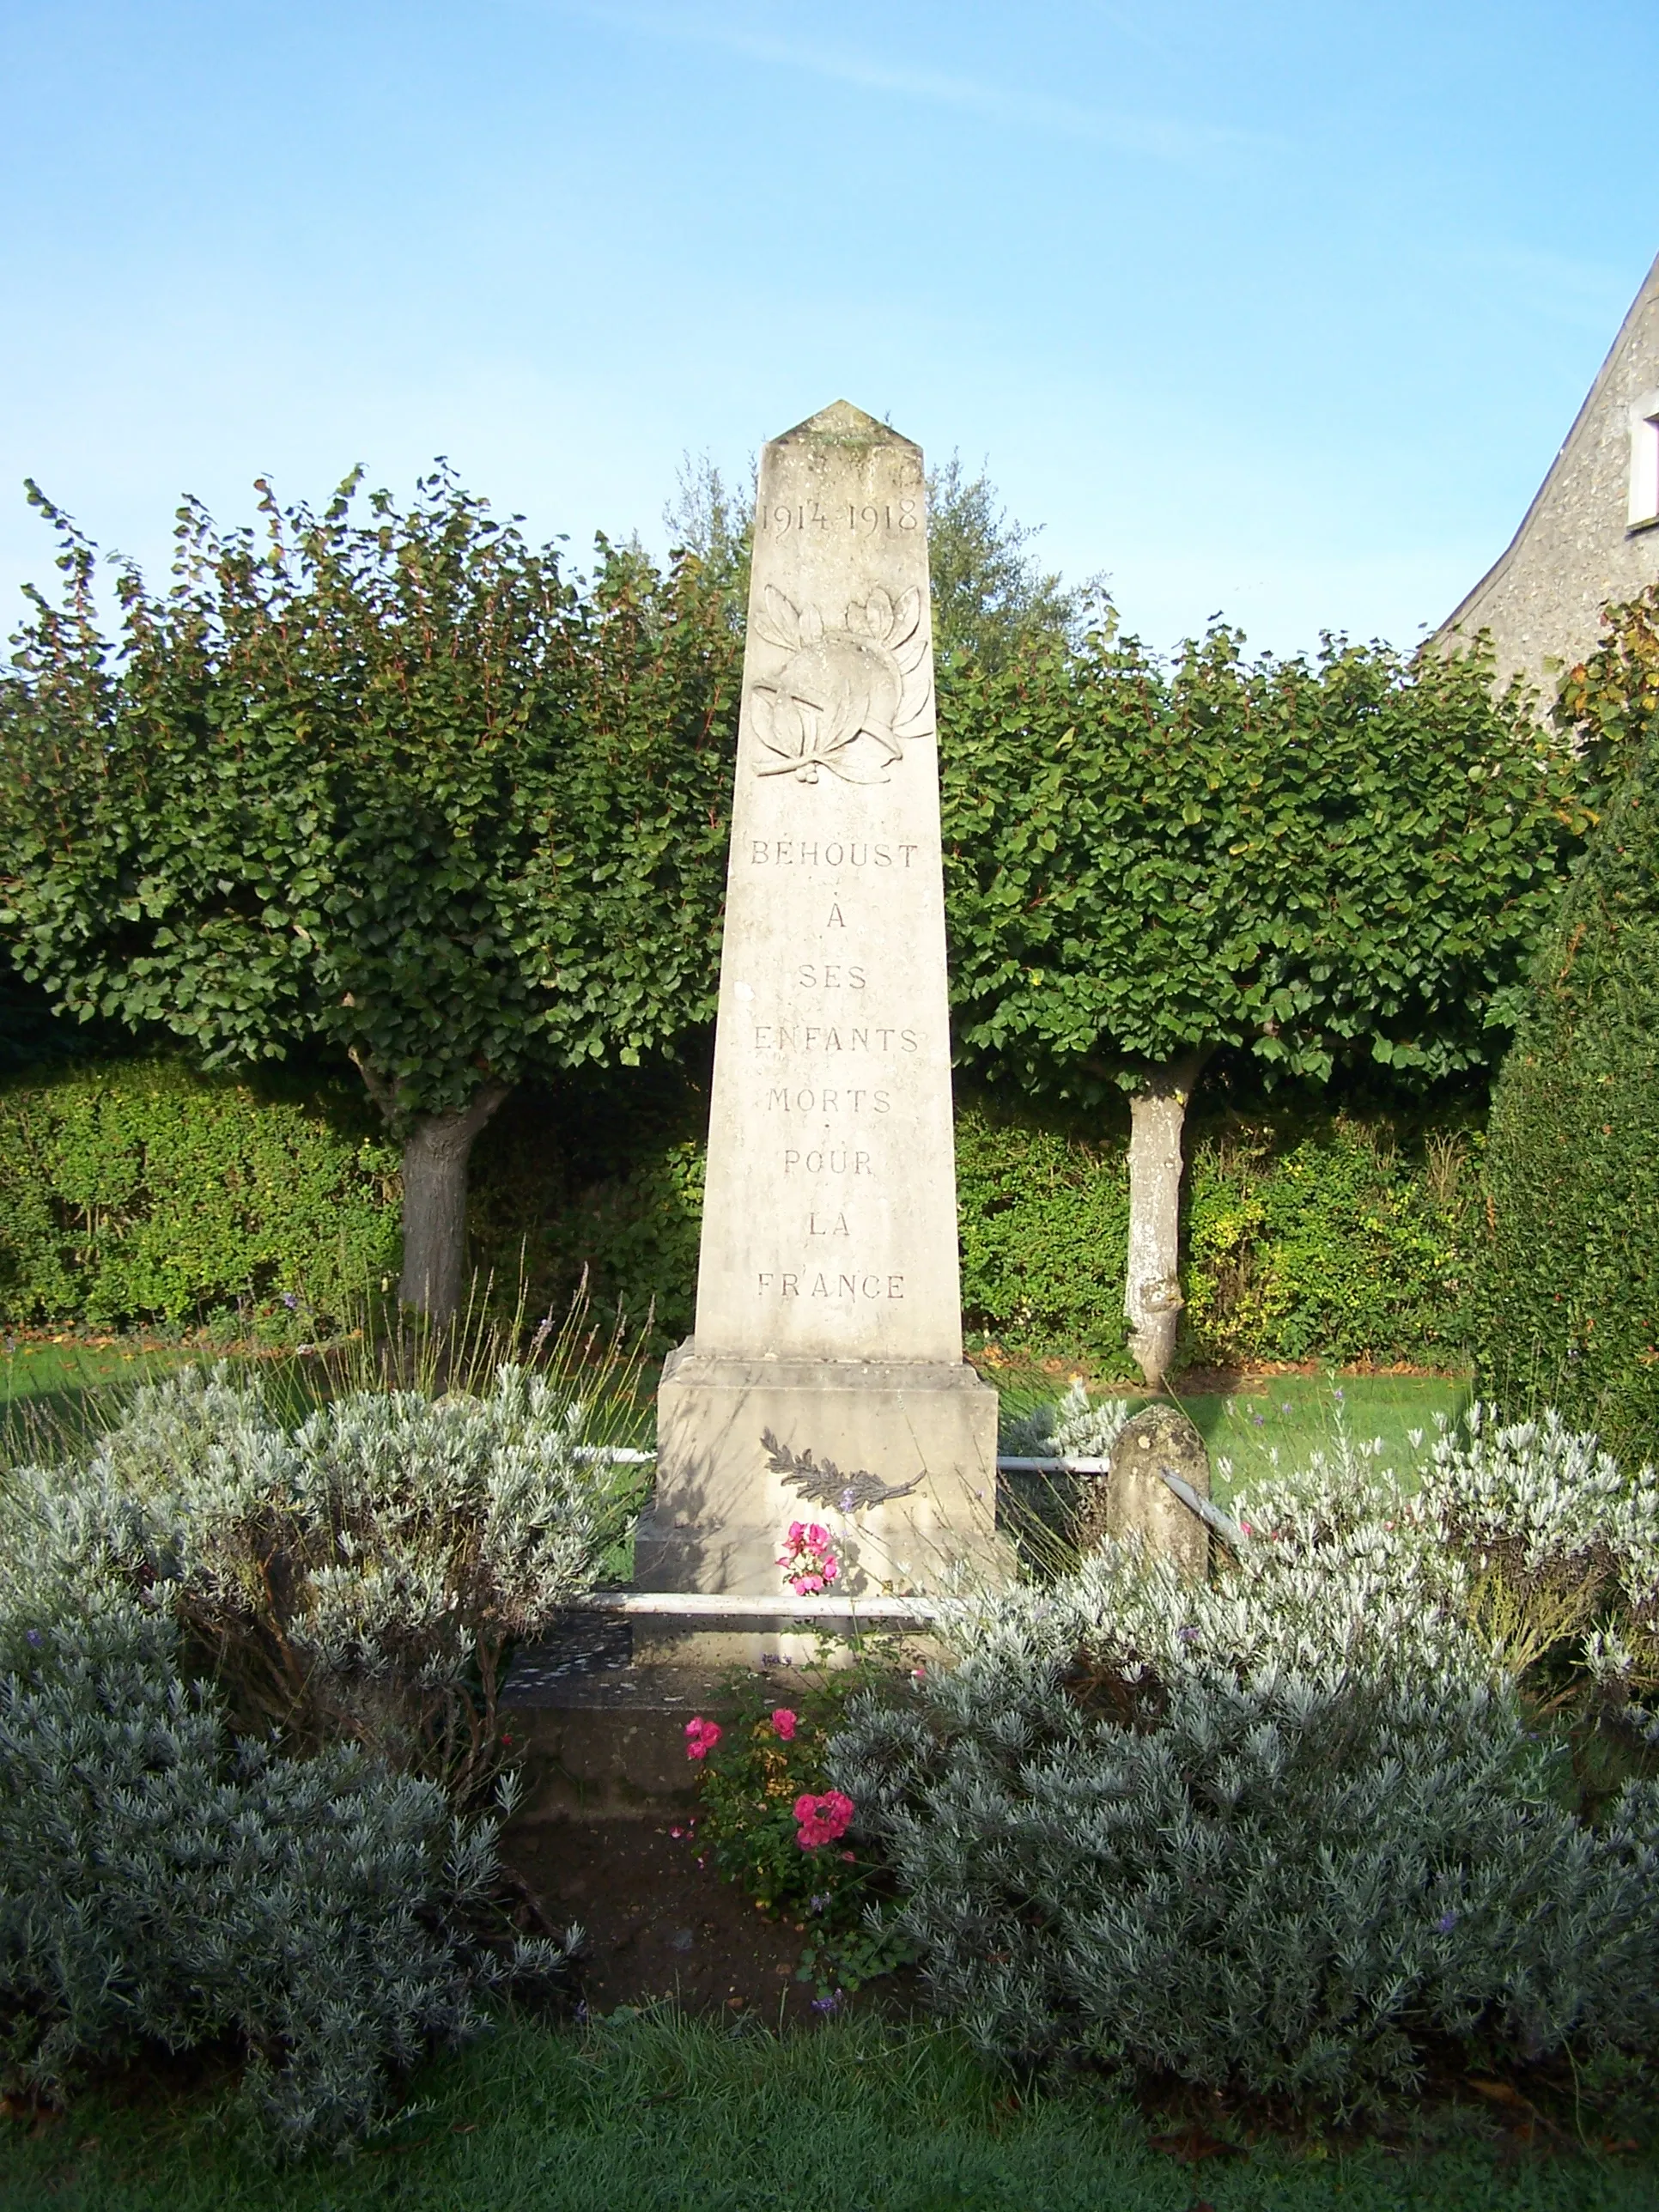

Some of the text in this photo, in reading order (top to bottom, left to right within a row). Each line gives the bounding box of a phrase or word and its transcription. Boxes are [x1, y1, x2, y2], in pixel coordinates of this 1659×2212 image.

[798, 963, 867, 989] SES
[755, 1025, 918, 1053] ENFANTS
[768, 1087, 890, 1114] MORTS
[784, 1149, 872, 1175] POUR
[809, 1212, 850, 1237] LA
[757, 1273, 904, 1301] FRANCE
